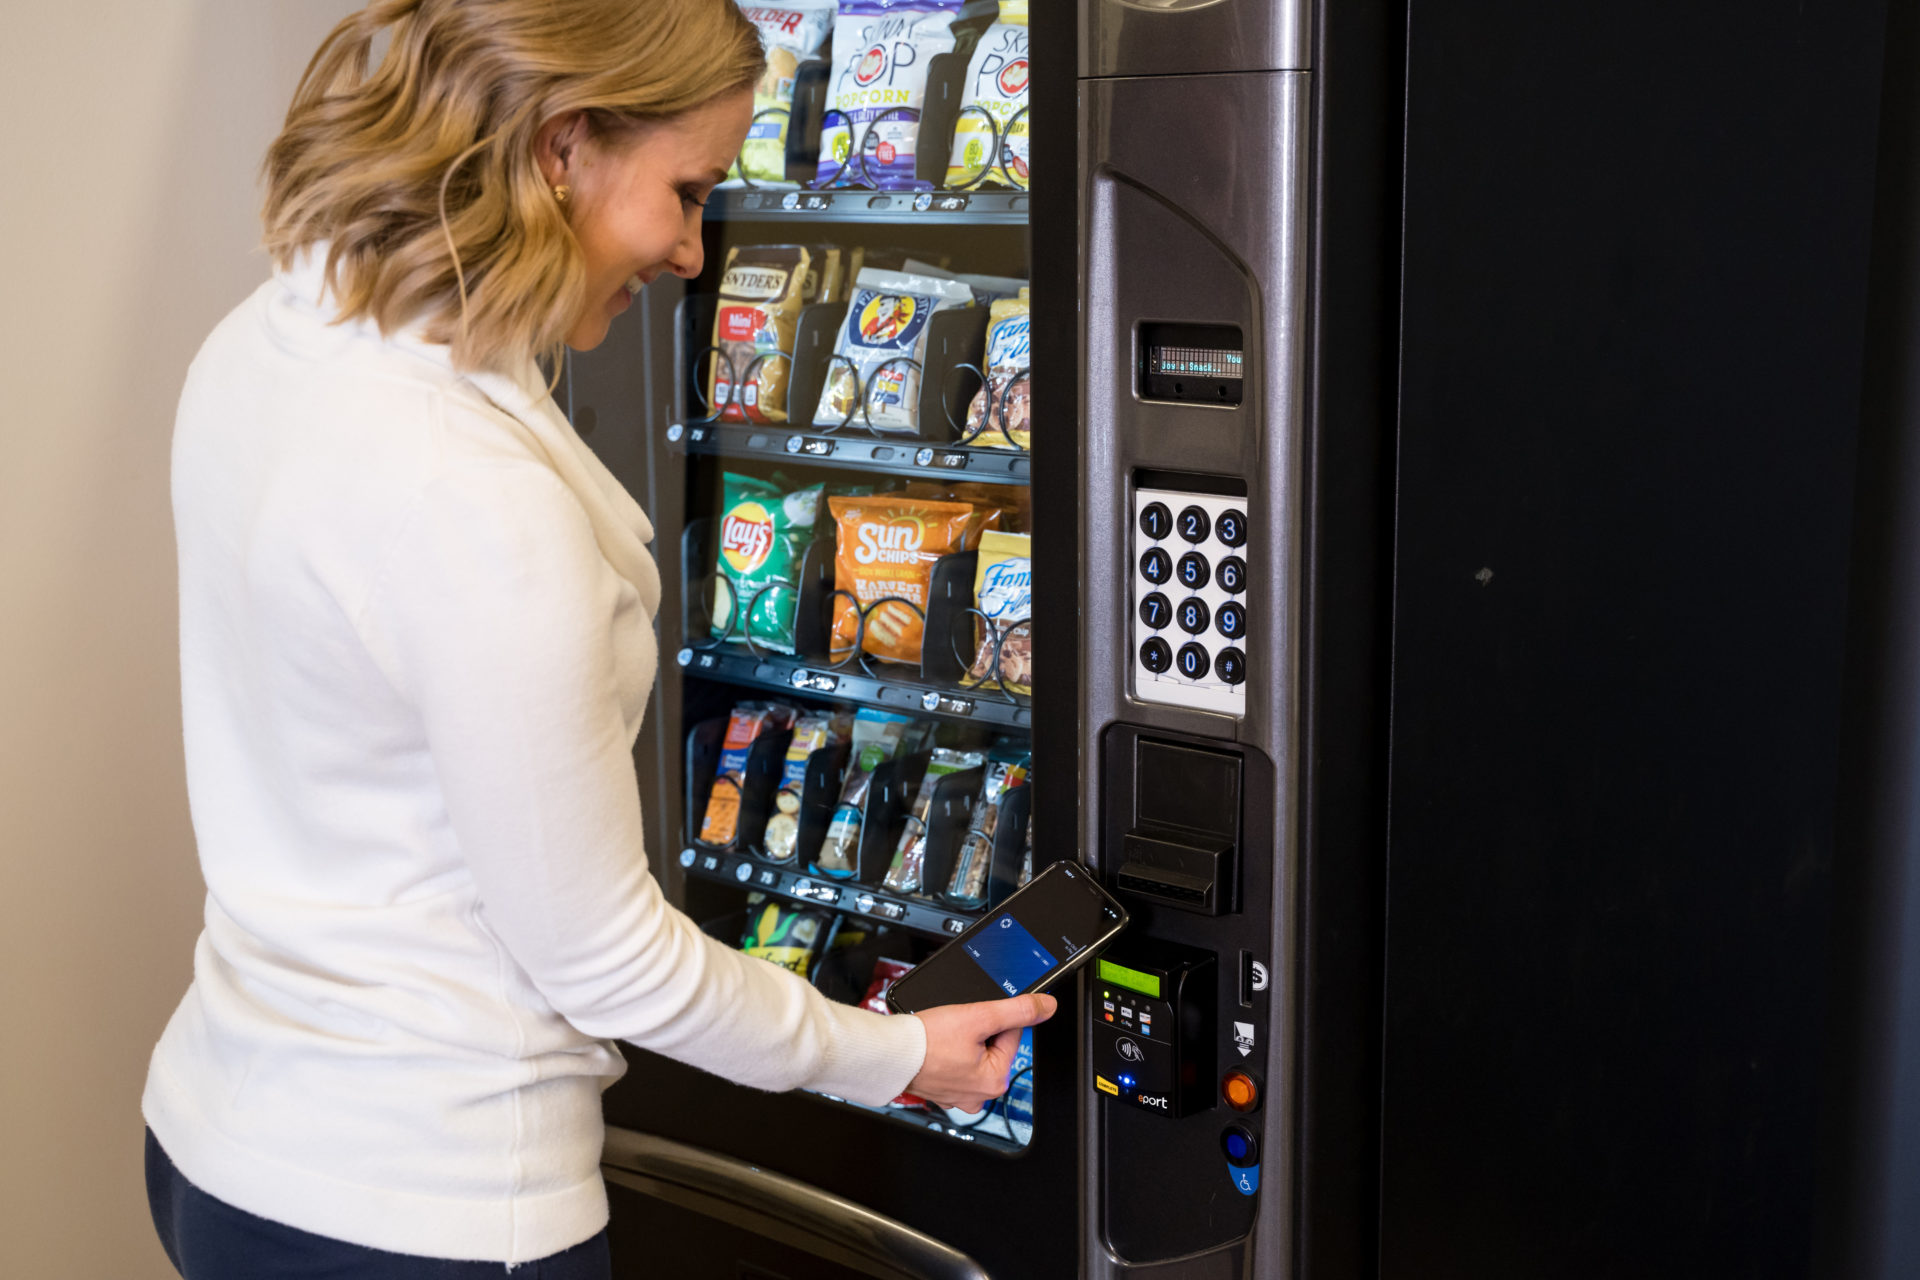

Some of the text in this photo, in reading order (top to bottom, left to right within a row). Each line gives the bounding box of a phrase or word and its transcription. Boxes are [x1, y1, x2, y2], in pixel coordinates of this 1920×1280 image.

[835, 89, 910, 109] POPCORN
[728, 313, 752, 328] Mini
[1161, 361, 1176, 371] Joy
[1180, 363, 1185, 371] a
[1226, 354, 1242, 364] You
[944, 455, 958, 466] 75
[1149, 512, 1235, 540] 1 2 3
[723, 516, 771, 557] Lay's
[854, 522, 925, 564] Sun
[877, 549, 919, 565] CHIPS
[1147, 557, 1236, 586] 4 5 6
[1149, 602, 1235, 633] 7 8 9
[1186, 652, 1196, 672] 0
[952, 700, 966, 712] 75
[950, 920, 964, 933] 75
[1002, 979, 1018, 996] VISA
[1138, 1094, 1168, 1109] eport
